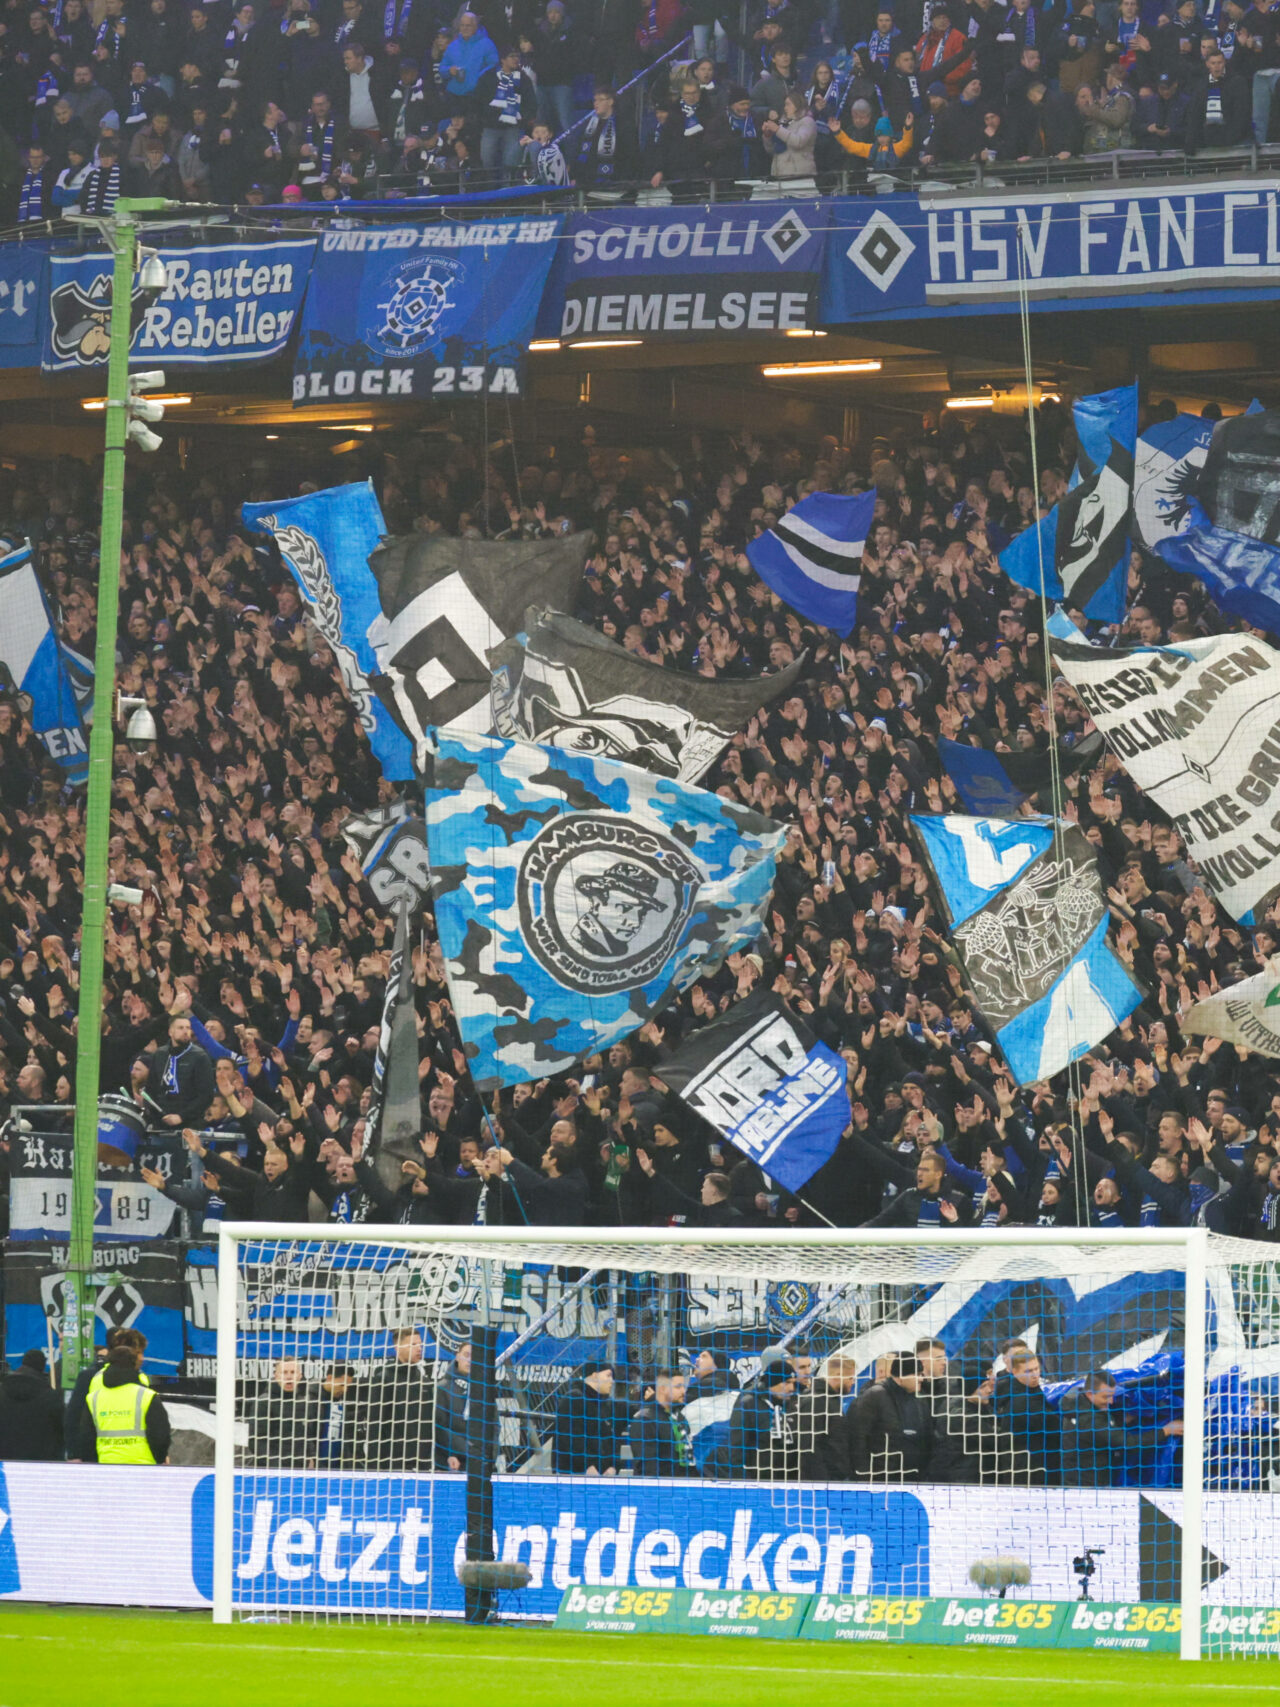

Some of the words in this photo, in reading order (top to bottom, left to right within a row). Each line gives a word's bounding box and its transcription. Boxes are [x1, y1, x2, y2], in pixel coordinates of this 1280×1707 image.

[323, 228, 418, 251] UNITED
[419, 223, 513, 248] FAMILY
[516, 221, 558, 243] HH
[574, 220, 759, 264] SCHOLLI
[928, 206, 1052, 282] HSV
[1080, 197, 1195, 274] FAN
[161, 259, 293, 301] Rauten
[561, 292, 808, 336] DIEMELSEE
[293, 369, 414, 400] BLOCK
[432, 367, 519, 394] 23A
[1199, 793, 1251, 841] DIE
[525, 821, 661, 882] HAMBURG
[531, 917, 561, 958] WIR
[556, 954, 591, 982] SIND
[19, 1137, 173, 1181] Harg
[41, 1192, 67, 1217] 19
[117, 1196, 151, 1221] 89
[51, 1246, 140, 1267] HBURG
[237, 1500, 428, 1586] Jetzt
[565, 1587, 672, 1616] bet365
[688, 1591, 796, 1623] bet365
[813, 1596, 924, 1627] bet365
[942, 1600, 1056, 1629] bet365
[585, 1621, 636, 1632] SPORTWETTEN
[708, 1625, 760, 1635] SPORTWETTEN
[1072, 1603, 1181, 1634] bet365
[834, 1629, 887, 1641] SPORTWETTEN
[964, 1633, 1019, 1645] SPORTWETTEN
[1094, 1636, 1150, 1649] SPORTWETTEN
